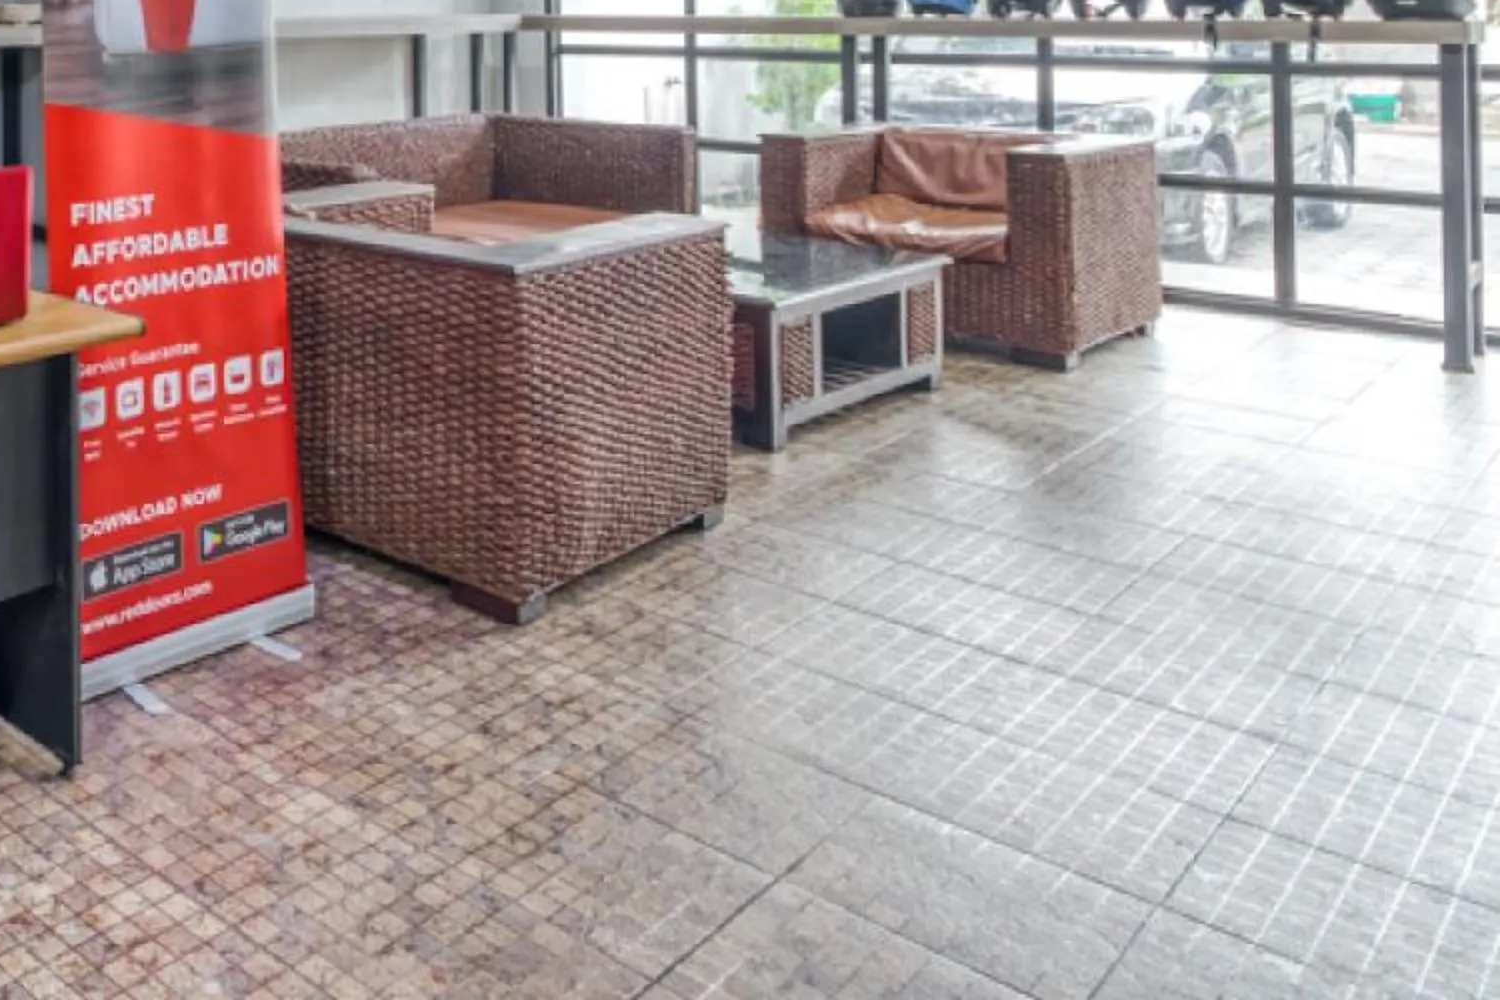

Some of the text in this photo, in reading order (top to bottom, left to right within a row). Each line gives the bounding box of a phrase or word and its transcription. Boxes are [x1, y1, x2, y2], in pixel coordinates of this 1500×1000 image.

[70, 193, 155, 227] FINEST
[72, 223, 229, 269] AFFORDABLE
[75, 254, 280, 306] ACCOMMODATION
[78, 483, 223, 541] DOWNLOAD NOW
